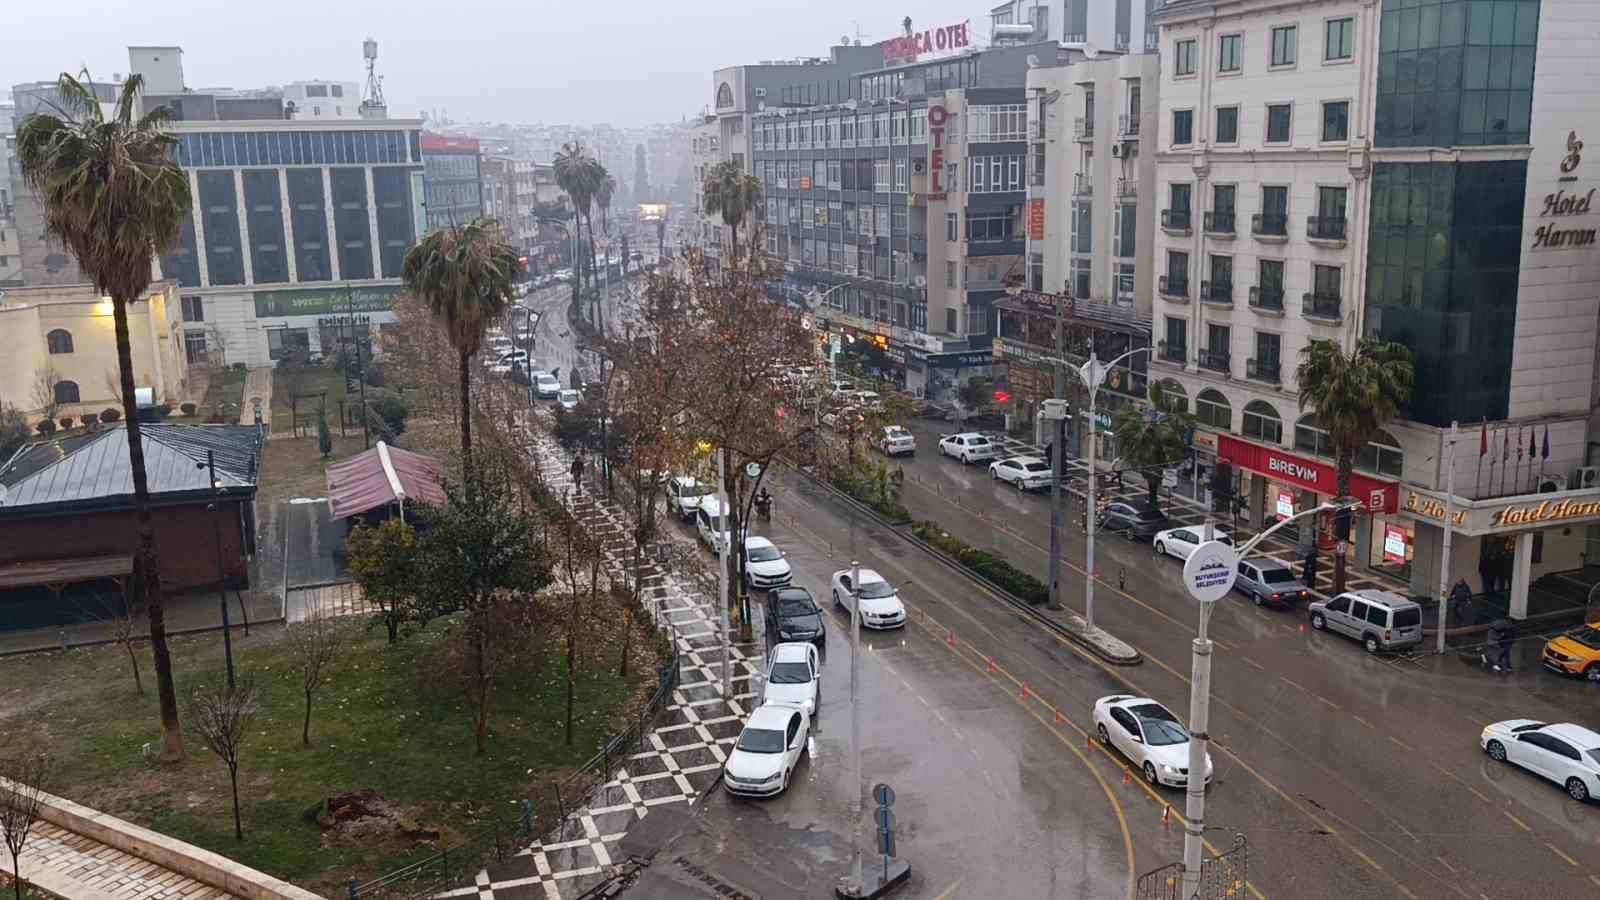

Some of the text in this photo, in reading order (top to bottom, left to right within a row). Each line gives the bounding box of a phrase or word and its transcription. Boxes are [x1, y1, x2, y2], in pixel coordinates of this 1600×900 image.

[936, 23, 969, 50] OTEL
[928, 105, 945, 192] OTEL
[1540, 188, 1597, 217] Hotel
[1531, 221, 1597, 249] Harran
[1489, 500, 1550, 527] Hotel
